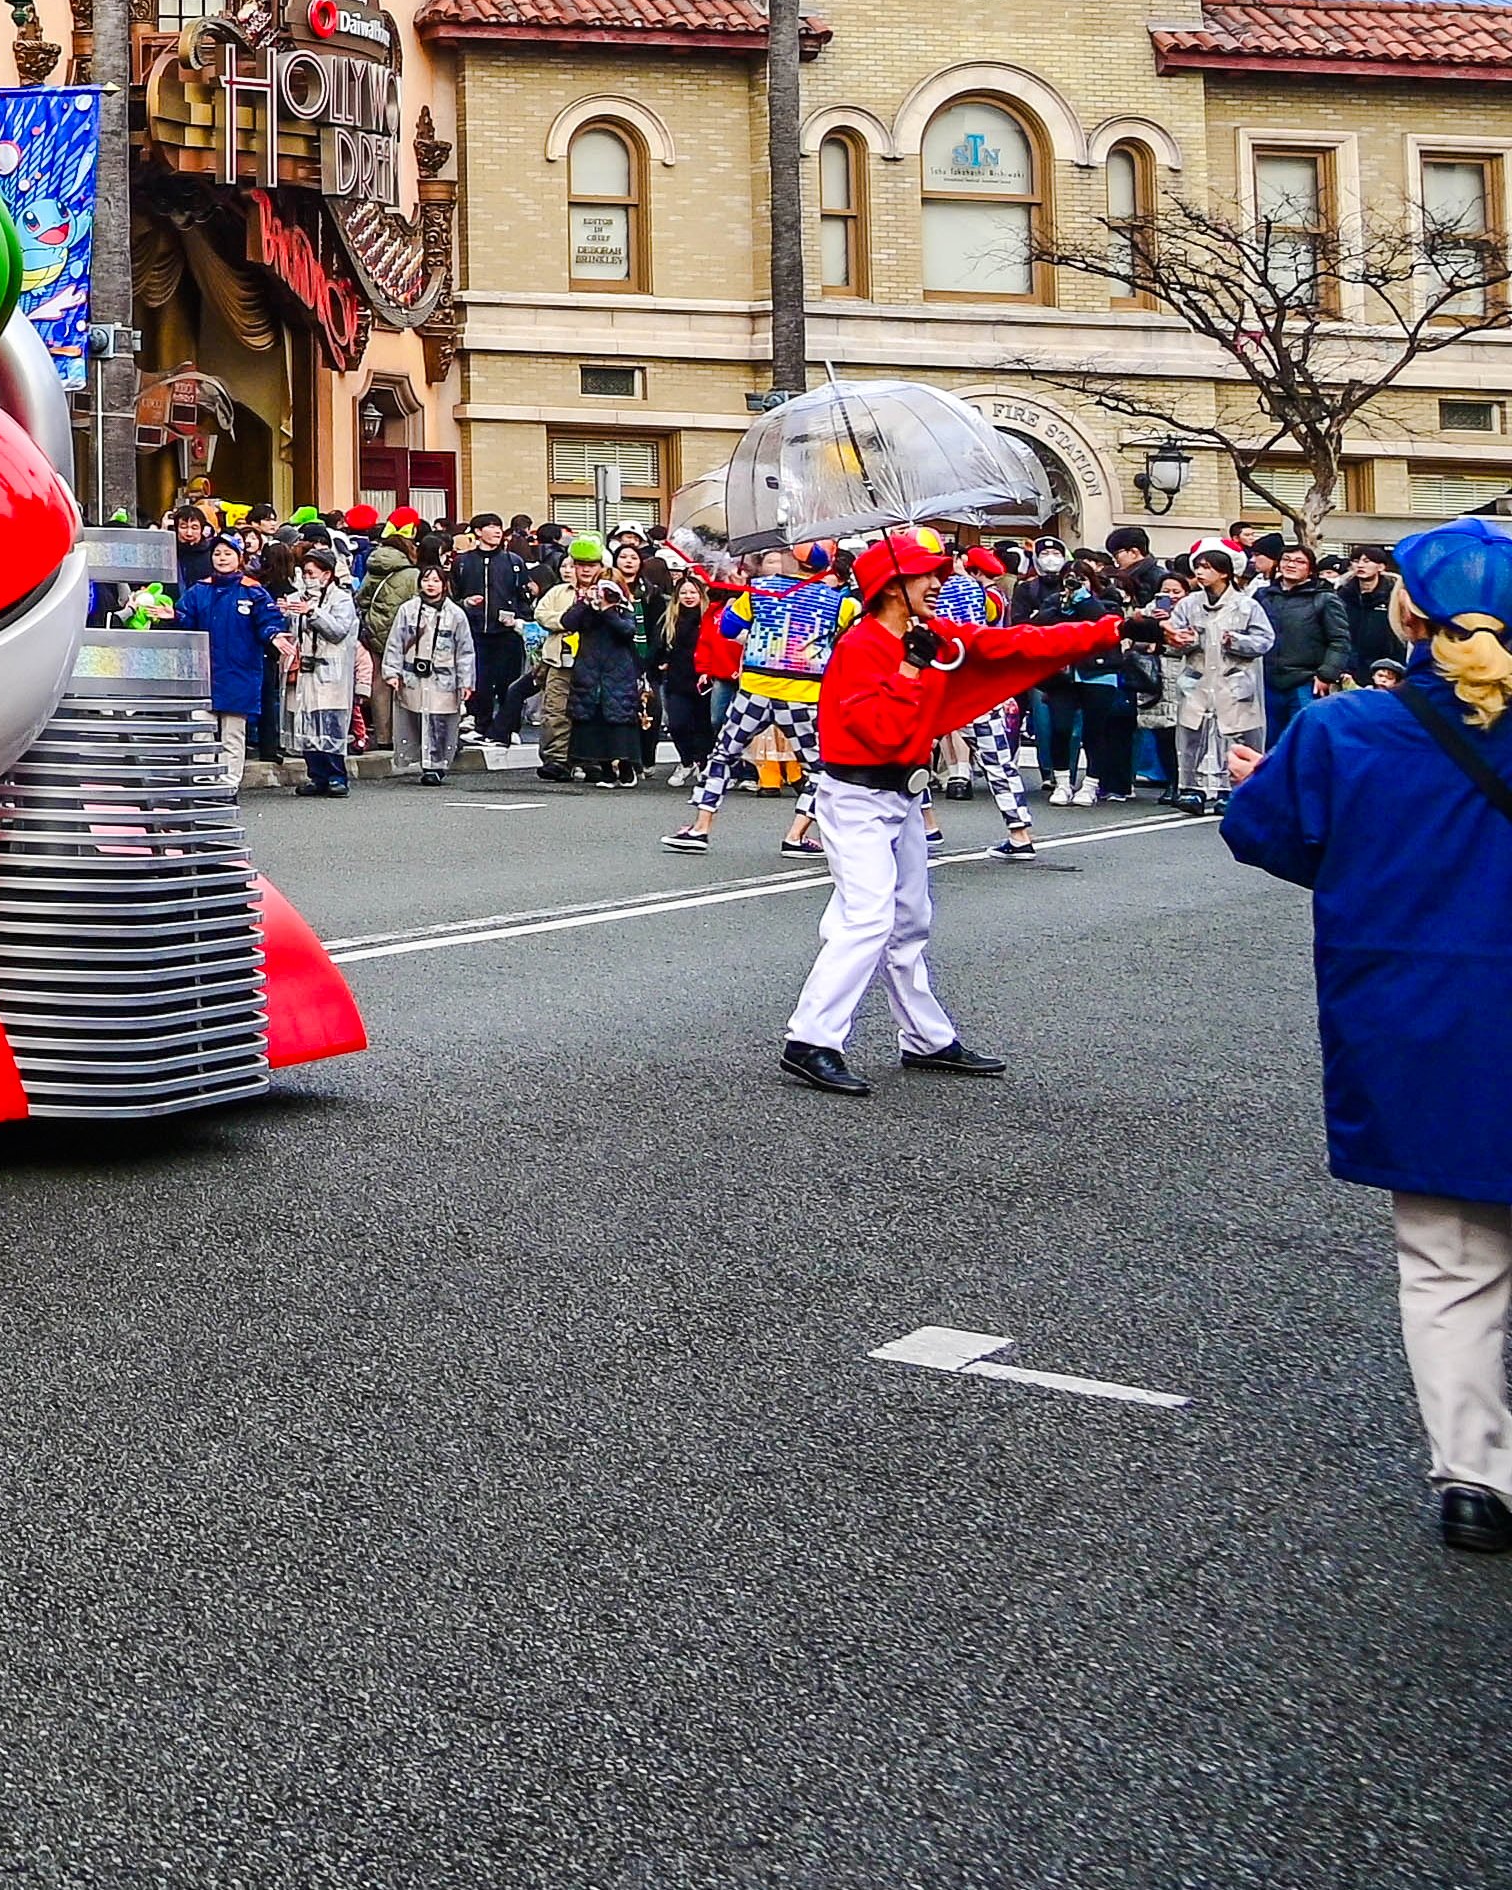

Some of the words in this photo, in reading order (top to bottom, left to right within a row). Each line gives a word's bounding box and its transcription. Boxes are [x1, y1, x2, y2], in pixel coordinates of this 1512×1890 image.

[951, 133, 1001, 167] STN
[992, 403, 1041, 428] FIRE
[1044, 423, 1103, 498] STATION
